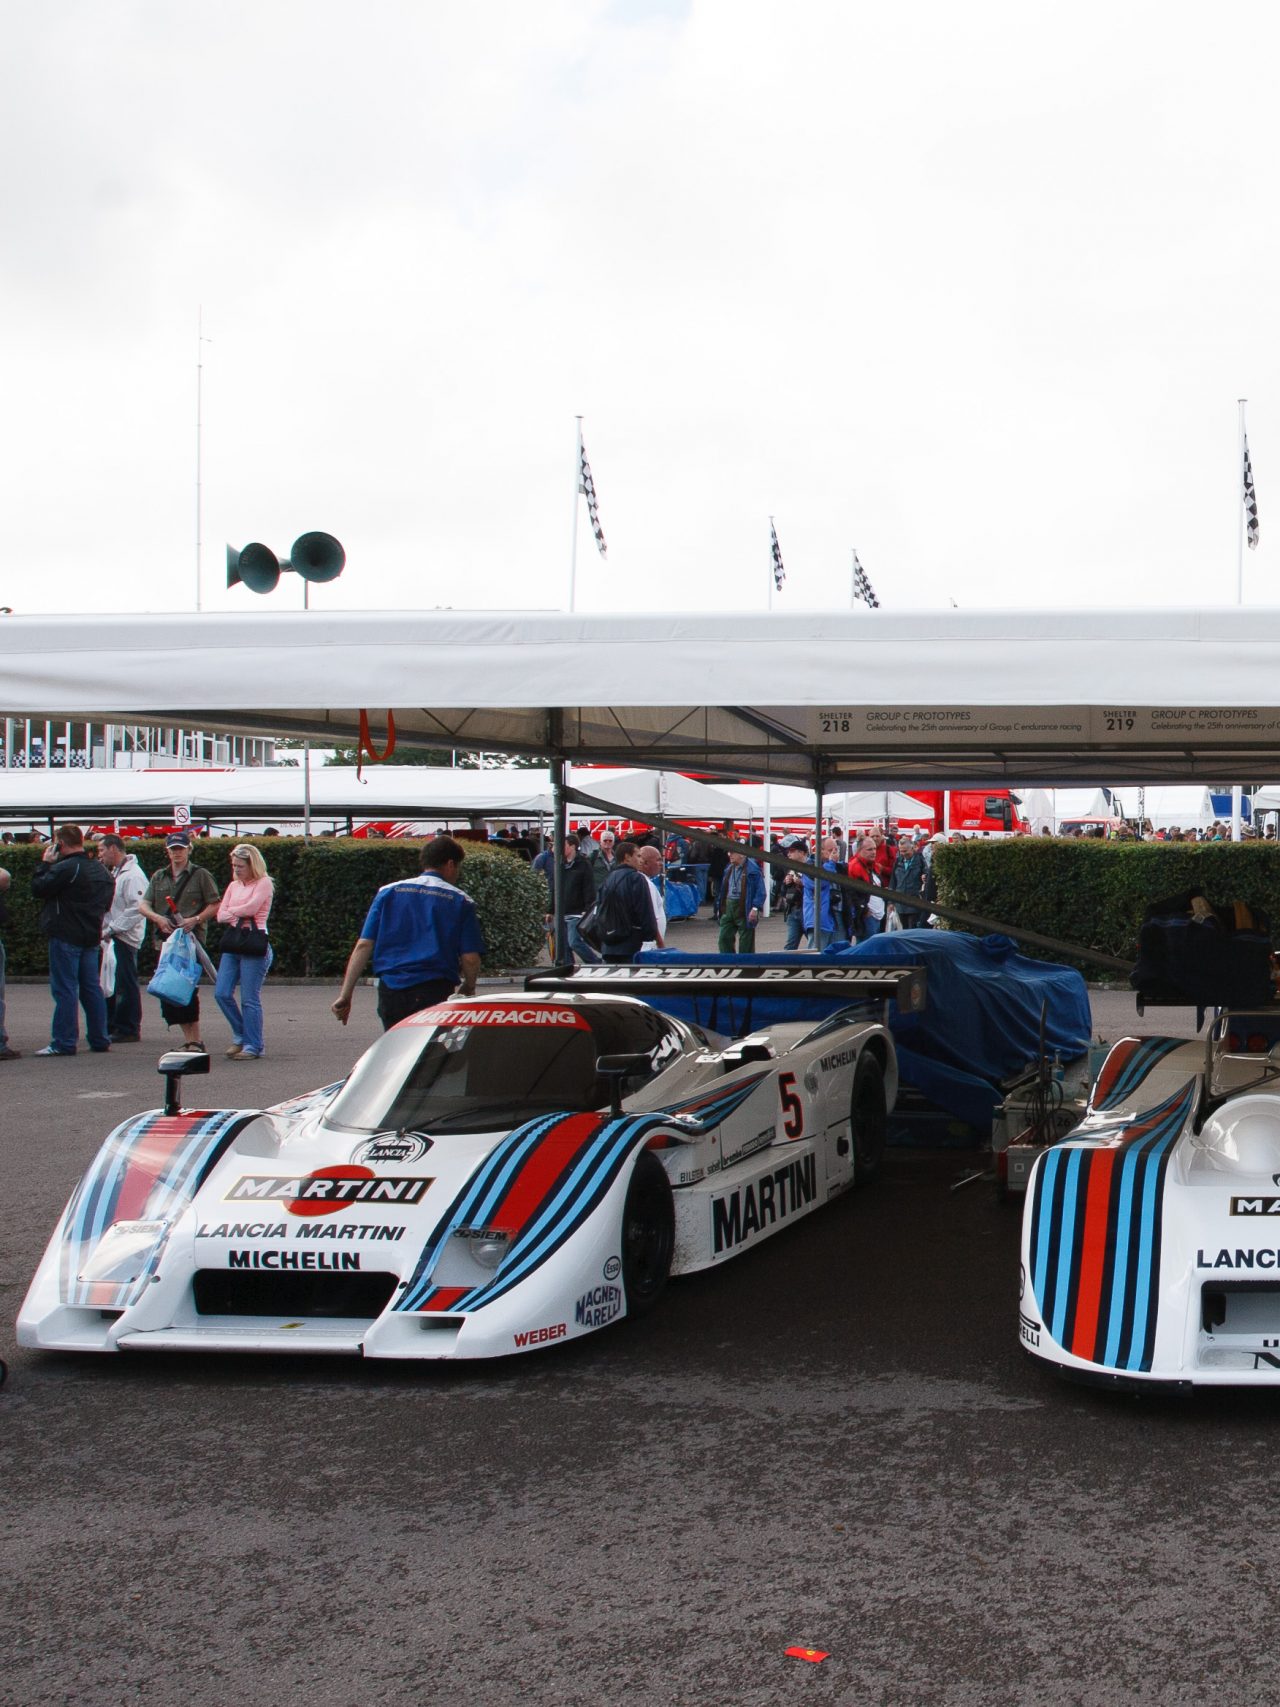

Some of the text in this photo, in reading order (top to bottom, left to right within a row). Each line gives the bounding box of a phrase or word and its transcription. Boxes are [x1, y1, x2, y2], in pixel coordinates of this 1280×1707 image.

[818, 712, 854, 720] SHELTER
[866, 711, 972, 721] GROUP C PROTOTYPES
[1102, 710, 1137, 719] SHELTER
[1151, 709, 1259, 720] GROUP C PROTOTYPES
[821, 720, 851, 733] 218
[865, 722, 1082, 733] Celebrating the 25th anniversary of Group C endurance racing
[1105, 718, 1135, 731] 219
[1151, 721, 1193, 731] Celebrating
[1193, 721, 1206, 731] the
[1207, 721, 1224, 730] 25th
[1224, 721, 1266, 731] anniversary
[1267, 721, 1276, 730] of
[573, 967, 912, 980] MARTINI RACING
[408, 1010, 577, 1025] MARTINI RACING
[819, 1049, 858, 1073] MICHELIN
[778, 1071, 804, 1140] 5
[369, 1148, 407, 1158] LANCIA
[232, 1178, 424, 1200] MARTINI
[713, 1151, 817, 1255] MARTINI
[195, 1222, 407, 1242] LANCIA MARTINI
[227, 1250, 362, 1270] MICHELIN
[513, 1322, 567, 1348] WEBER
